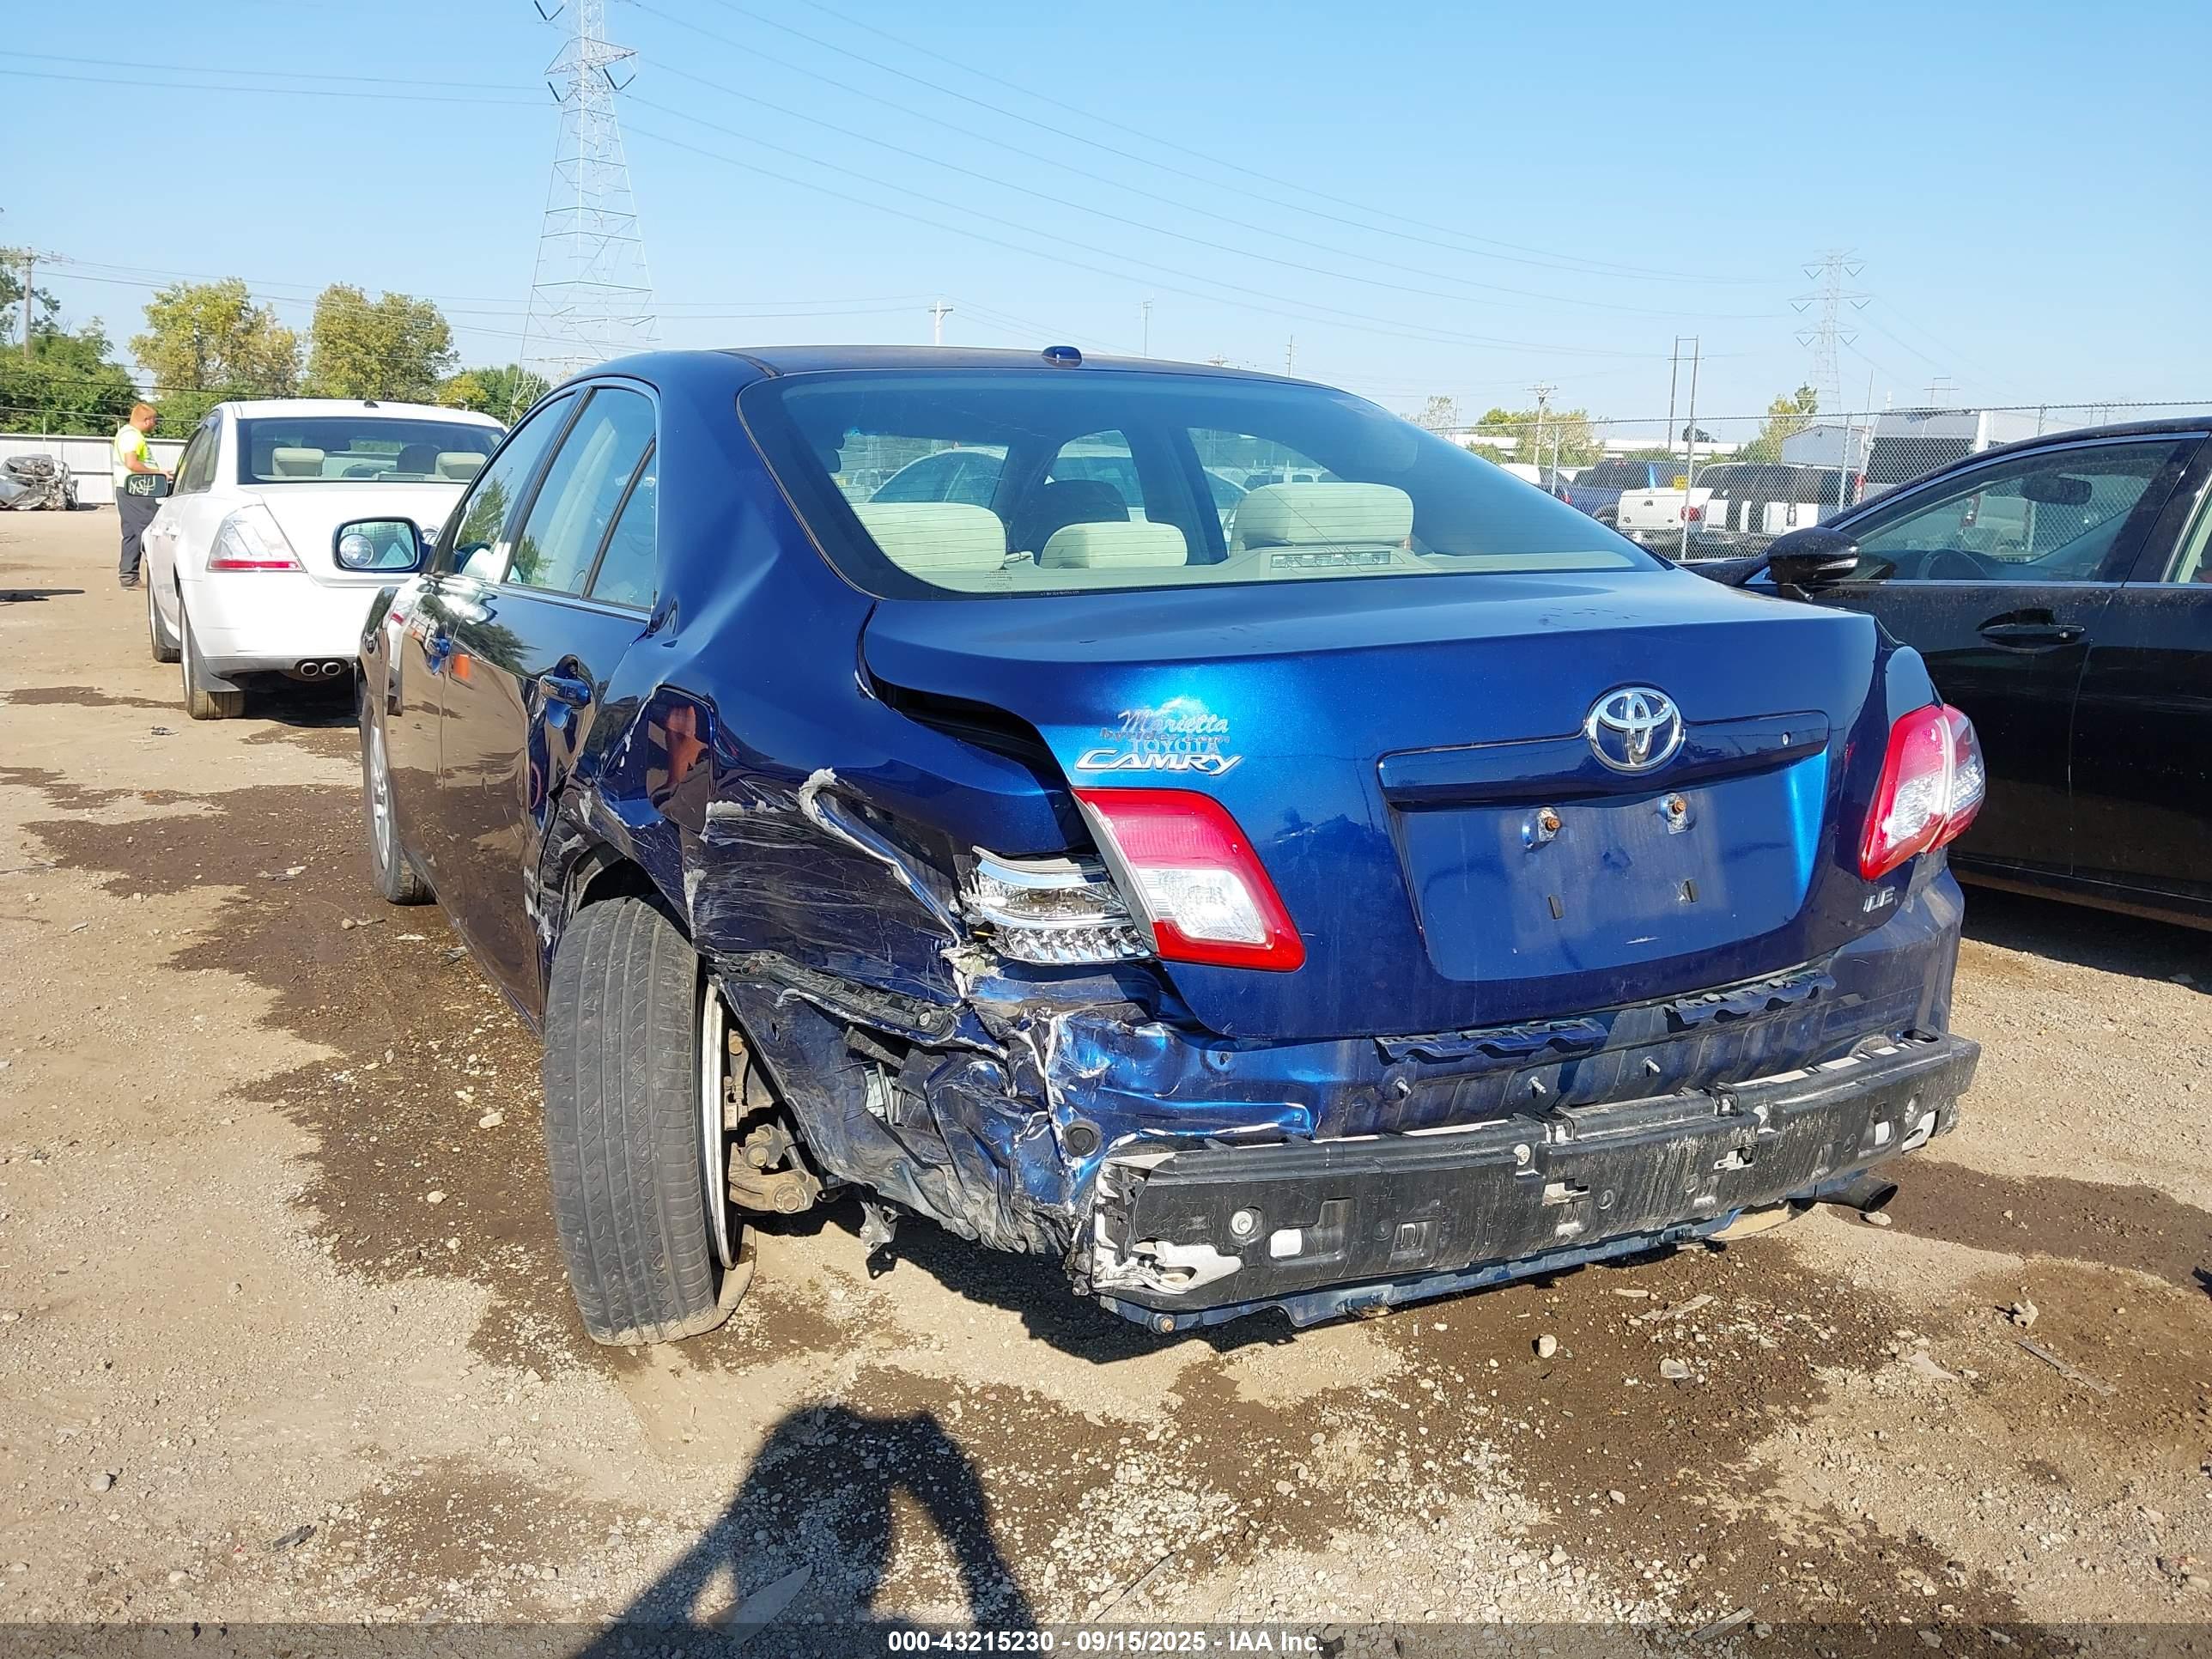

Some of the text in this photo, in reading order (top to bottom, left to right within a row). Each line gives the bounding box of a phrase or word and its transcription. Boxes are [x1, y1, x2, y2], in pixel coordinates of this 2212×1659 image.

[1118, 708, 1230, 734] Marietta
[1129, 738, 1220, 754] TOYOTA
[1076, 749, 1244, 776] CAMRY
